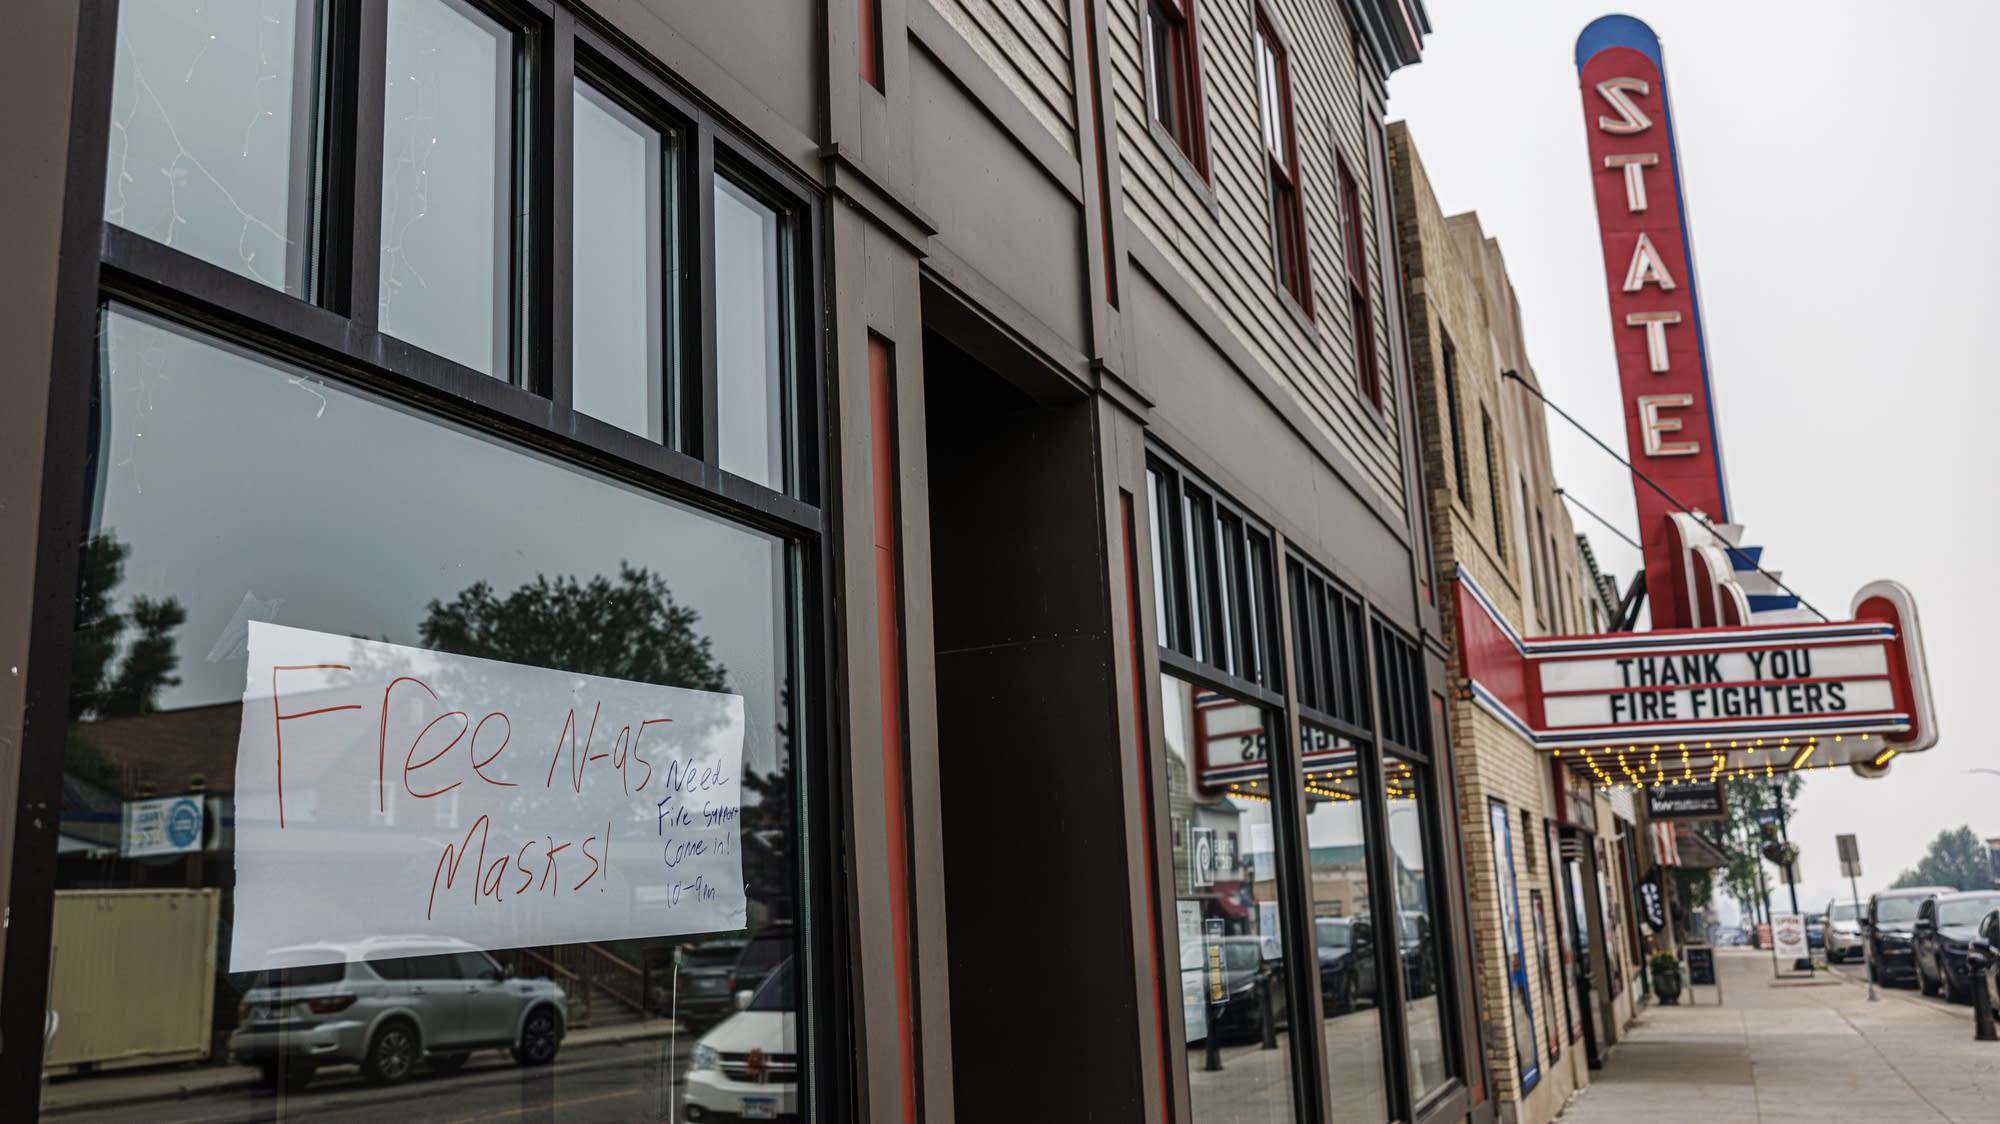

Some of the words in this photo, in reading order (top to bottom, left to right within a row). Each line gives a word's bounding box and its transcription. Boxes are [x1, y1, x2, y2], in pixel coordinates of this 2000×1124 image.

[1596, 77, 1700, 457] STATE
[1616, 653, 1723, 688] THANK
[1746, 648, 1812, 681] YOU
[1610, 690, 1677, 723] FIRE
[1691, 682, 1847, 718] FIGHTERS
[274, 664, 518, 829] Free
[547, 700, 674, 797] N-95
[666, 758, 729, 792] Need
[657, 796, 692, 836] Fire
[713, 832, 731, 855] in!
[427, 814, 612, 922] Masks!
